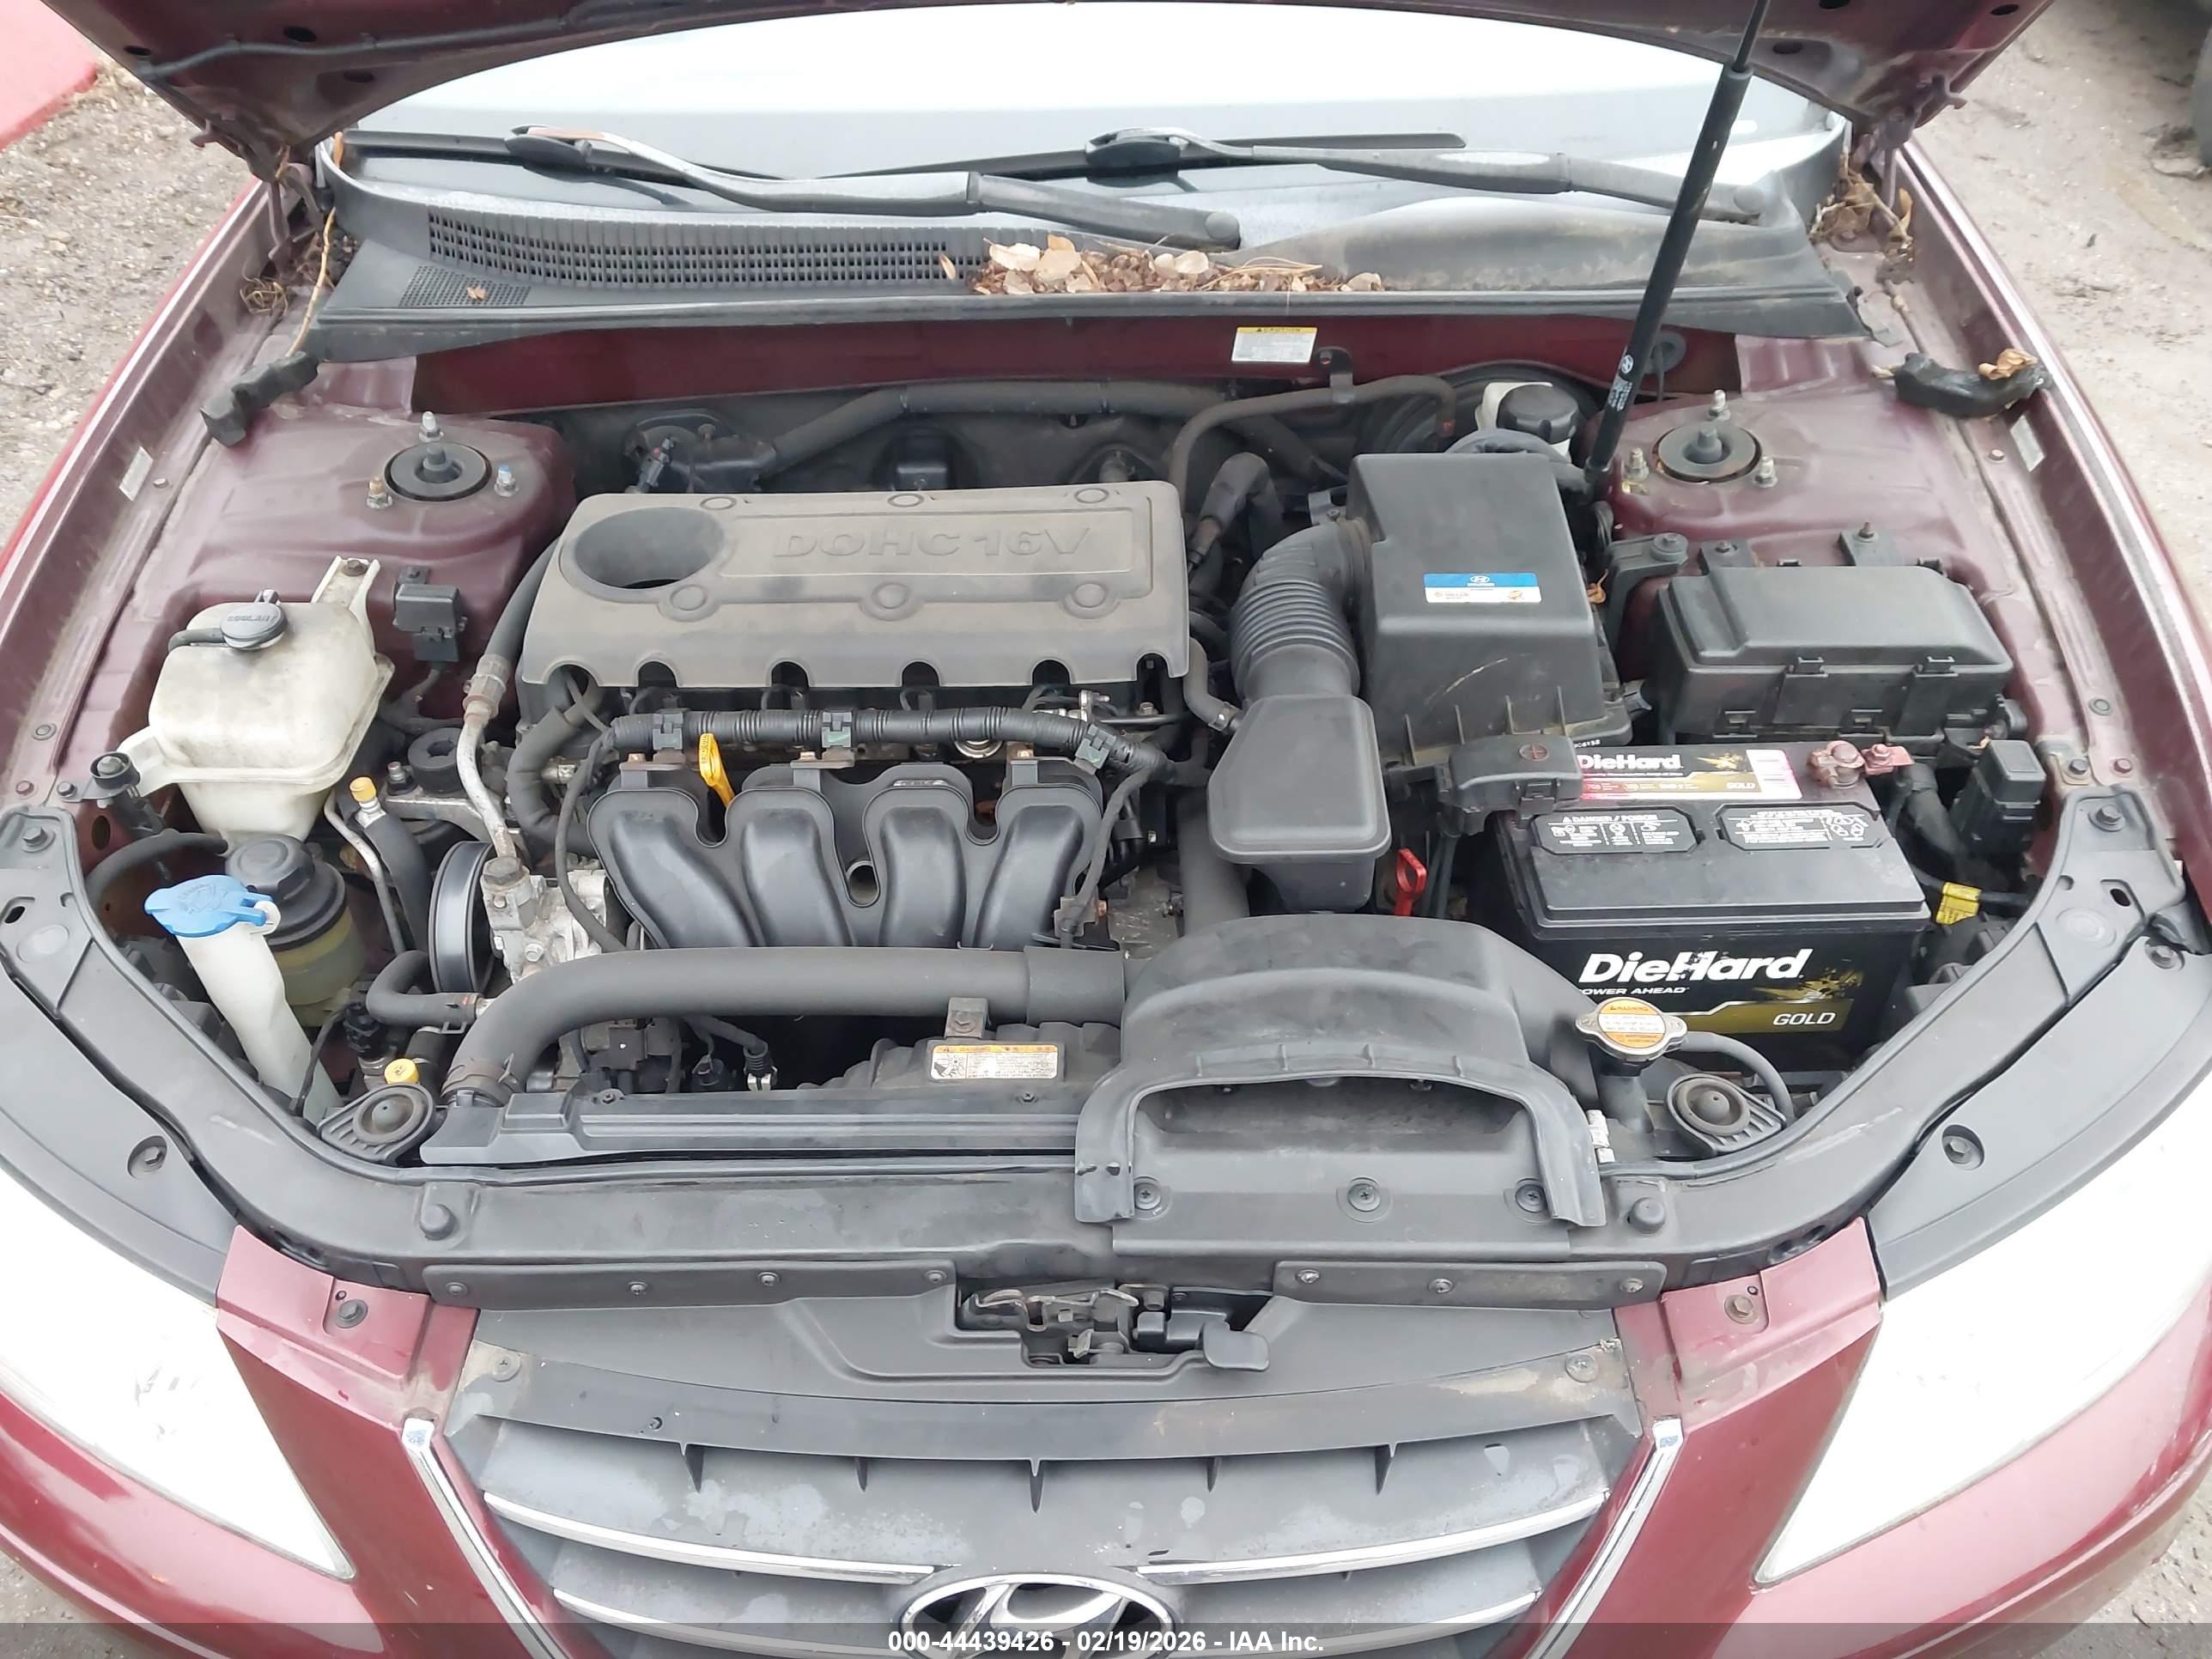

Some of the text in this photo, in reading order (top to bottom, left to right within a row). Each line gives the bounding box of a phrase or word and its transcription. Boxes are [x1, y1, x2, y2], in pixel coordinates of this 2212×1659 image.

[773, 527, 1091, 557] DOHC 16V
[227, 614, 278, 623] COOLANT
[1577, 754, 1681, 769] DieHard
[1578, 949, 1814, 982] DieHard
[1772, 1012, 1837, 1026] GOLD
